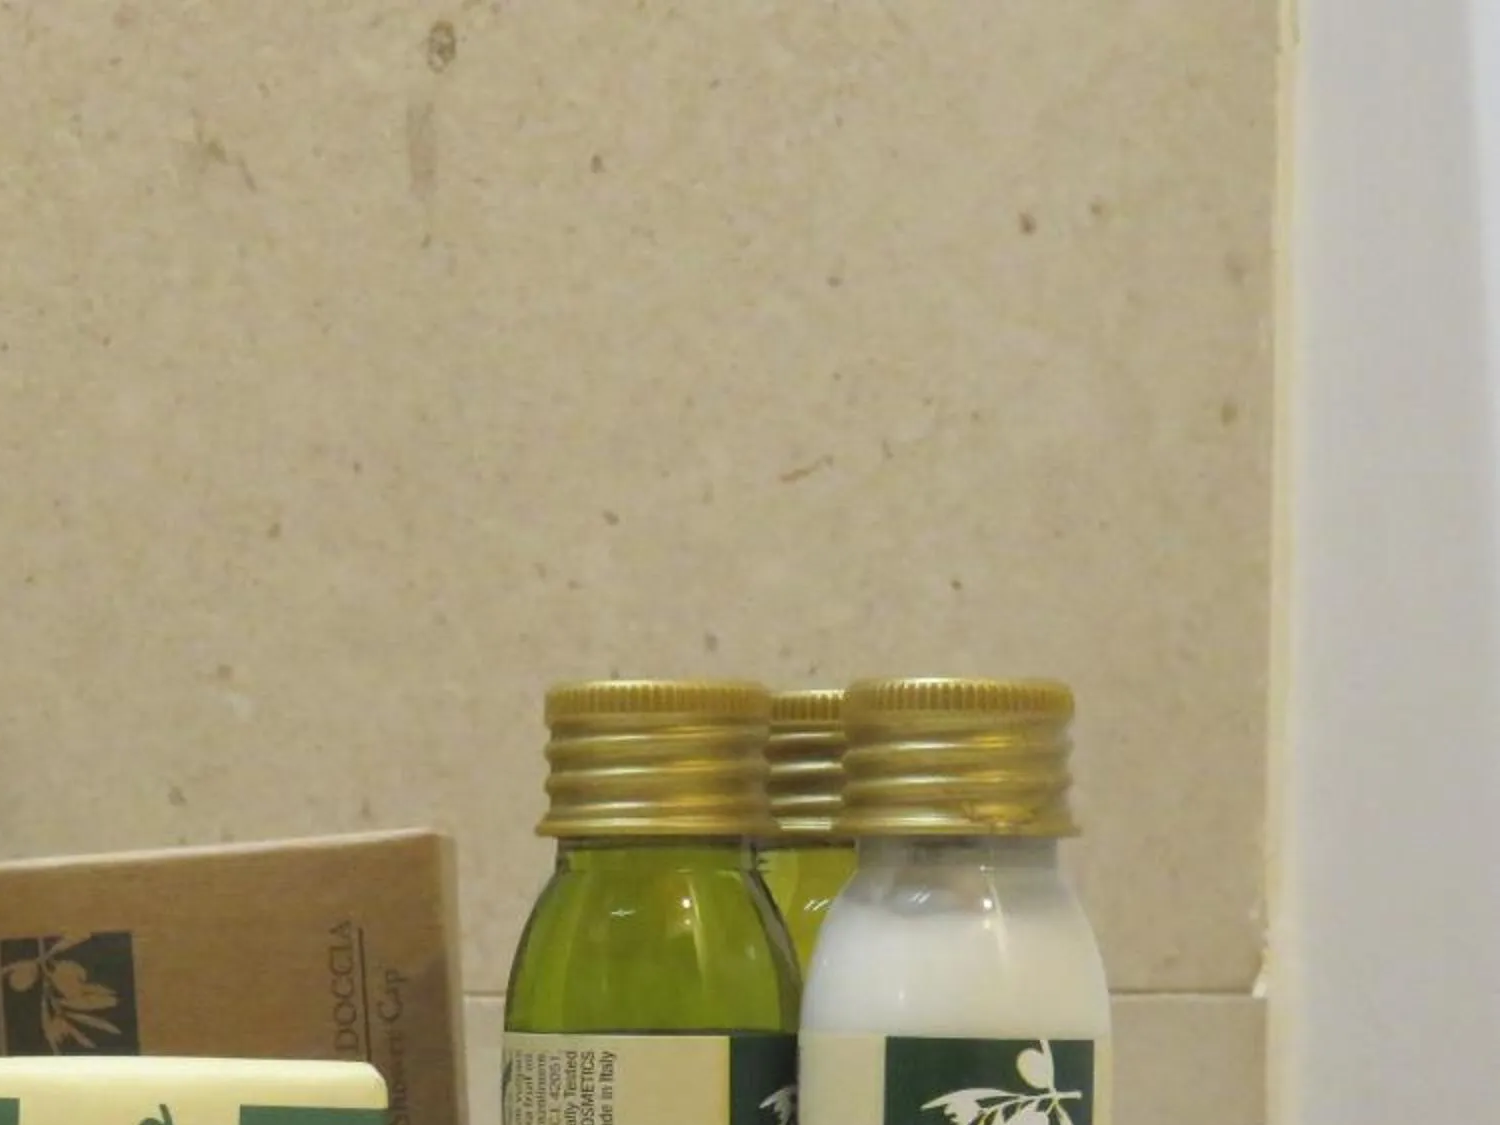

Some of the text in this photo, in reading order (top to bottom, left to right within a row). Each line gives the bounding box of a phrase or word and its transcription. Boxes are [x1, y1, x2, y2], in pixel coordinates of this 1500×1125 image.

[328, 919, 359, 1054] DOCCIA
[376, 967, 408, 1024] Cap
[563, 1050, 577, 1099] Tested
[598, 1050, 618, 1083] Italy
[599, 1086, 613, 1100] in
